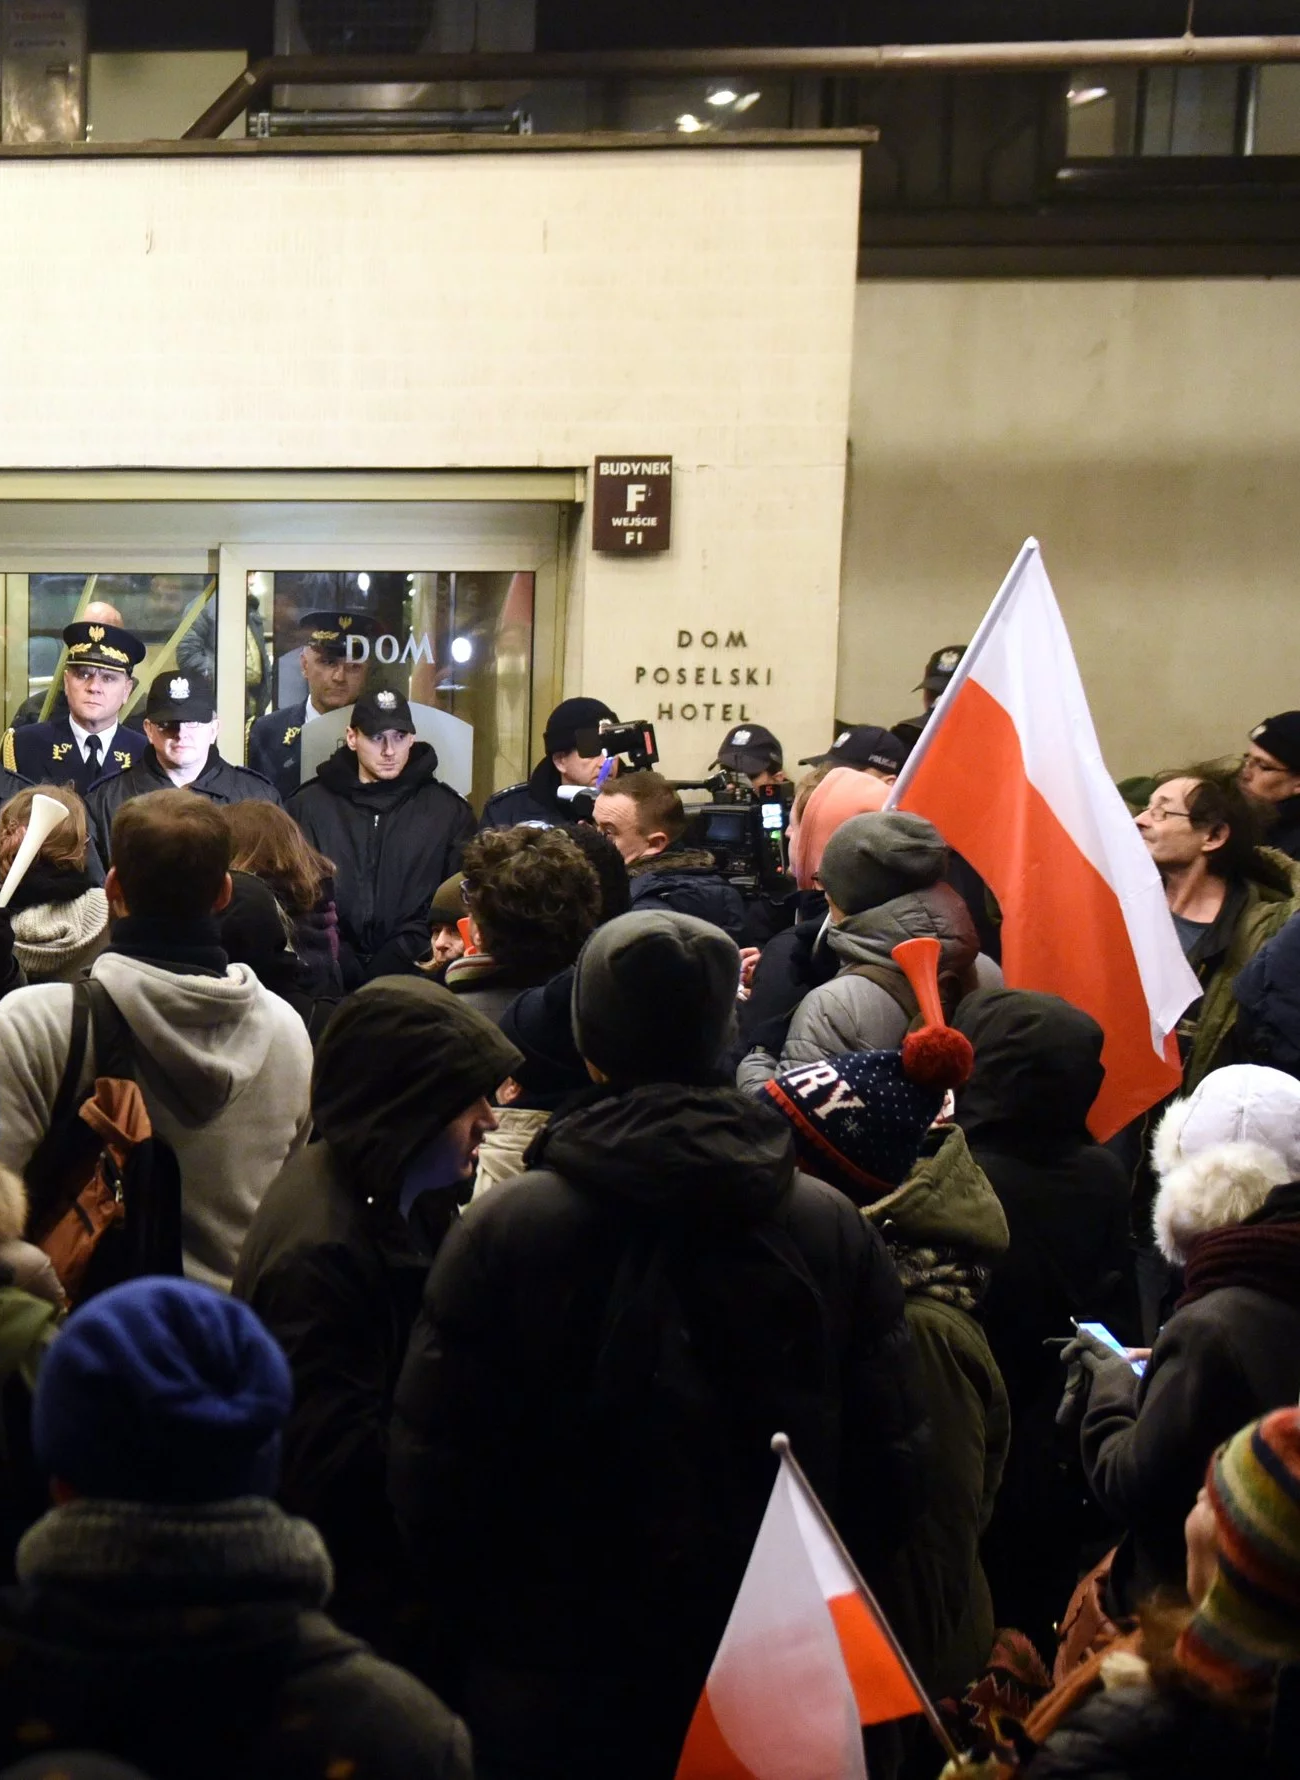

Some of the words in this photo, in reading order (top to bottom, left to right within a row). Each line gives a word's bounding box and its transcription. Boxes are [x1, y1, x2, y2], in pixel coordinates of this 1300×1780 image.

[599, 462, 670, 475] BUDYNEK
[626, 484, 646, 512] F
[611, 513, 657, 527] WEJŚCIE
[677, 630, 748, 648] DOM
[346, 632, 435, 665] DOM
[635, 666, 772, 685] POSELSKI
[657, 703, 751, 721] HOTEL
